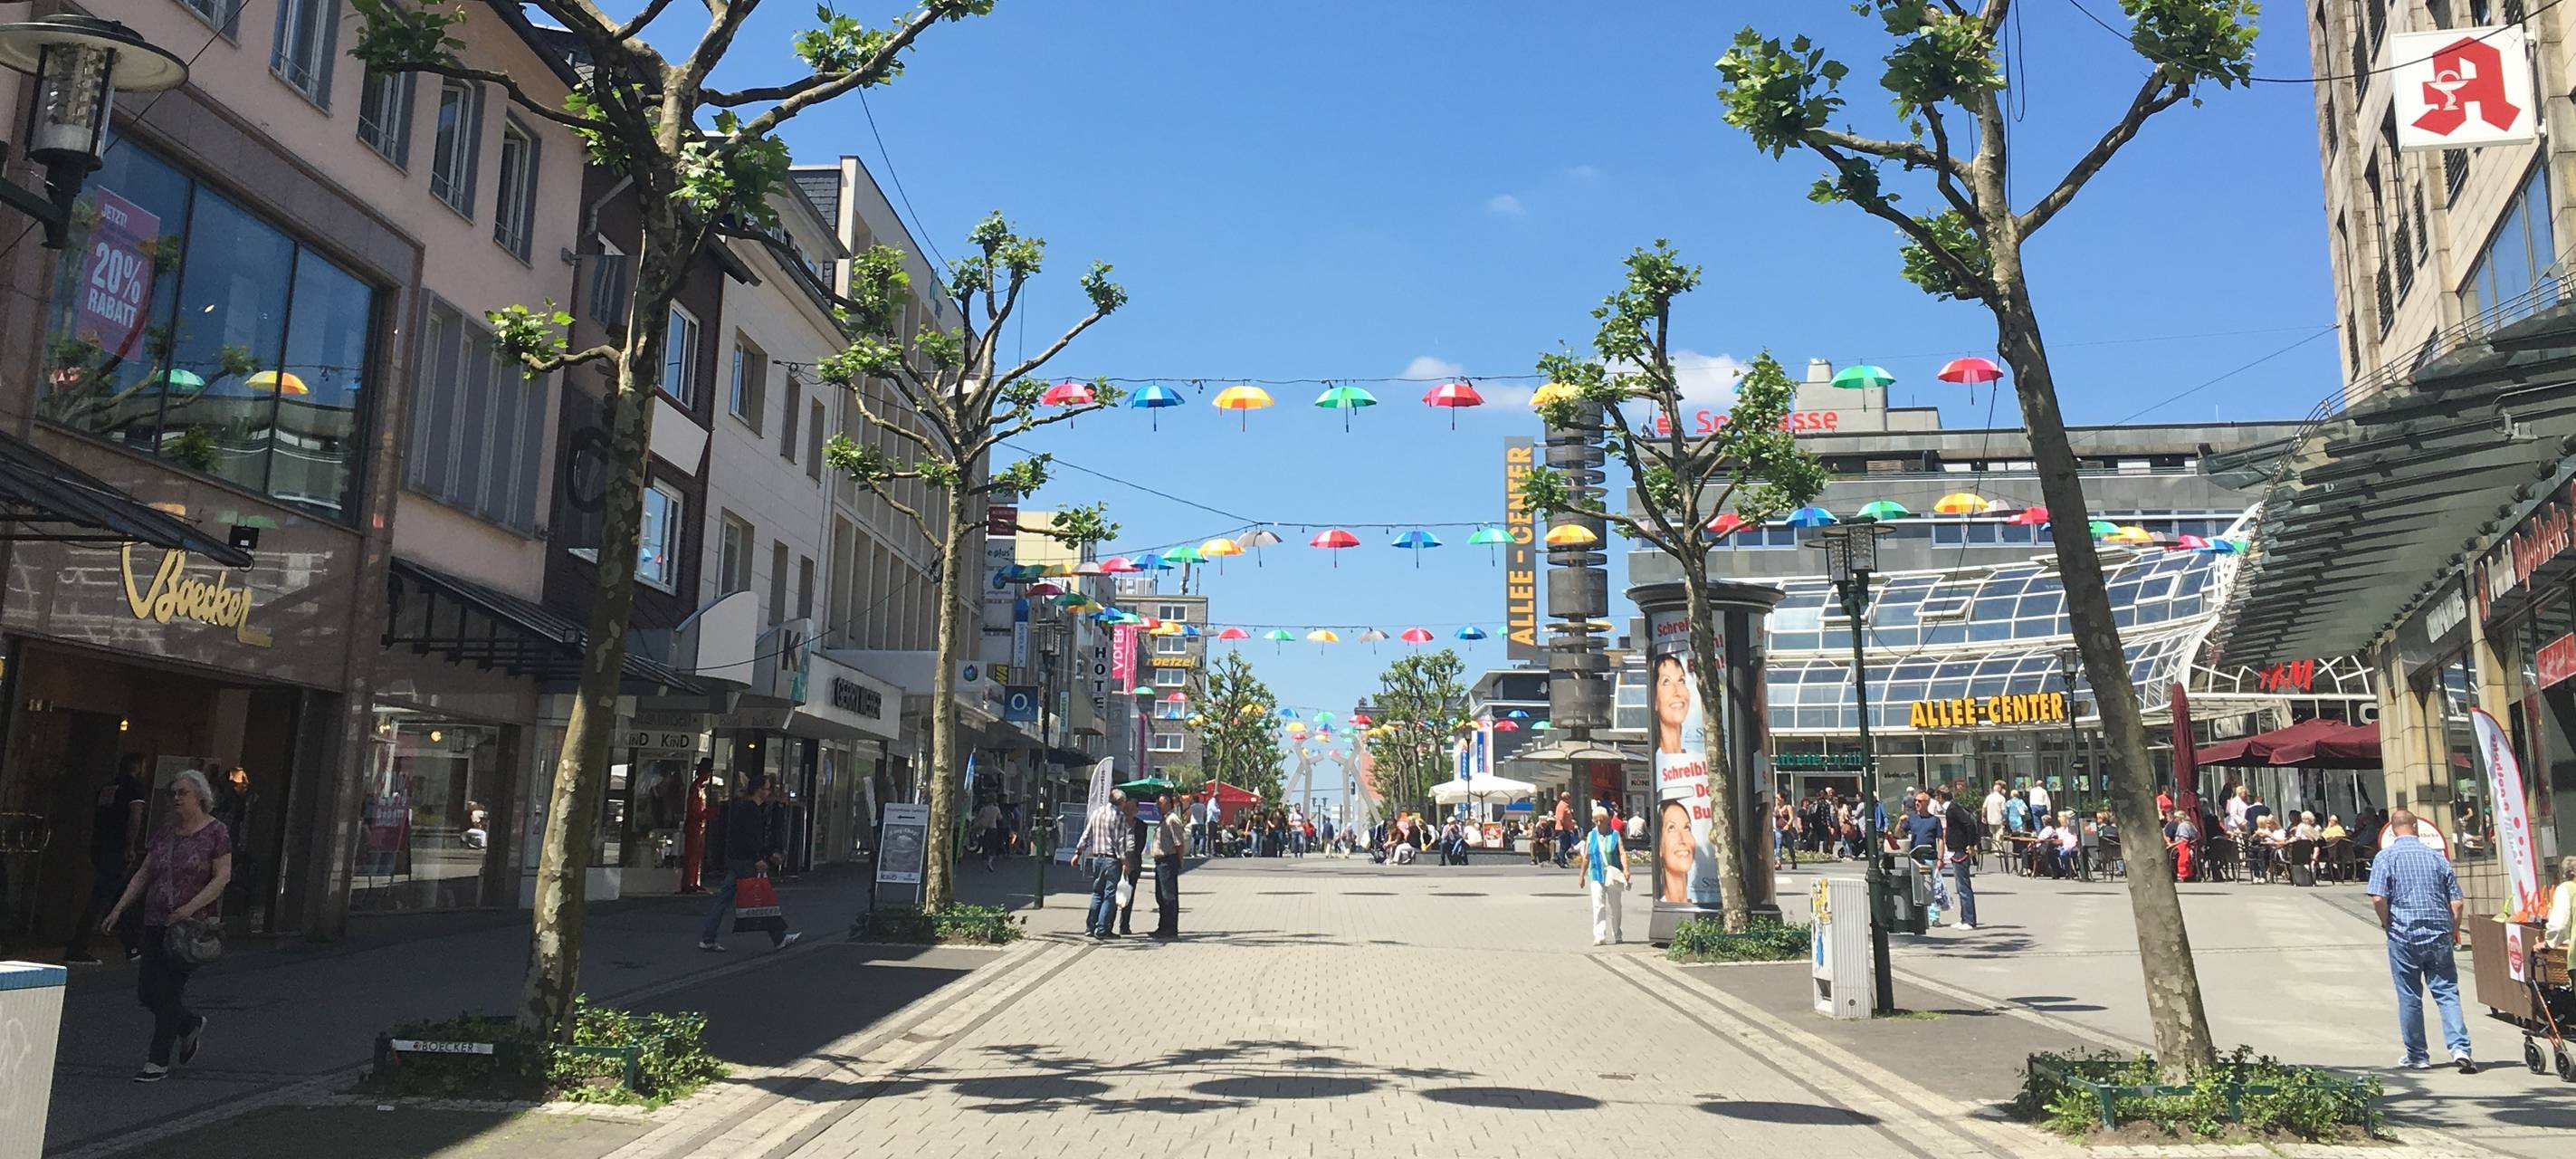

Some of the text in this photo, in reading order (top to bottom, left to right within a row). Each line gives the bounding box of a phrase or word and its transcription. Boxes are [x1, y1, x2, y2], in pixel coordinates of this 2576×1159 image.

[100, 203, 129, 228] JETZT!
[91, 242, 141, 304] 20%
[87, 288, 137, 329] RABATT
[1695, 408, 1838, 434] Spasse
[1662, 761, 1708, 781] Schreib!
[422, 1041, 474, 1052] BOECKER
